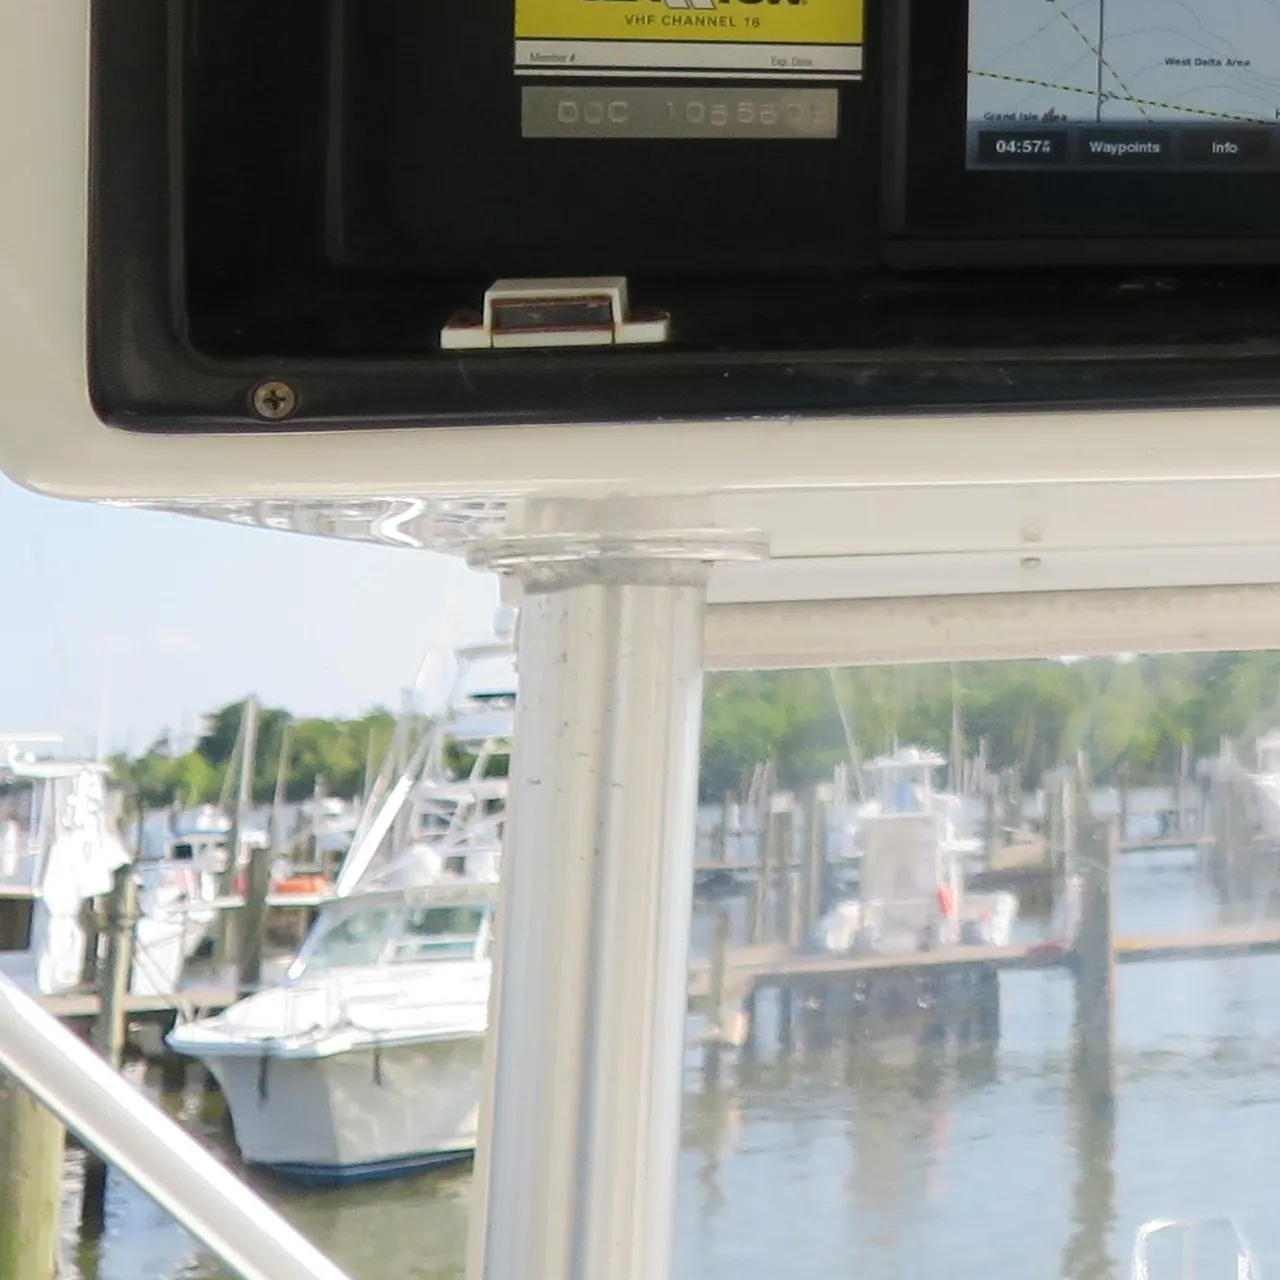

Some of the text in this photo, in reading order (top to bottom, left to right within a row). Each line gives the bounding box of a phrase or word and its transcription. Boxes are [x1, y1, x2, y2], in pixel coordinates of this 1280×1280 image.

[625, 14, 761, 29] VHF CHANNEL 16
[1165, 58, 1250, 67] West Delta Area
[984, 111, 1016, 121] Grand
[995, 140, 1041, 154] 04:57
[1089, 140, 1160, 157] Waypoints
[1212, 140, 1238, 154] Info
